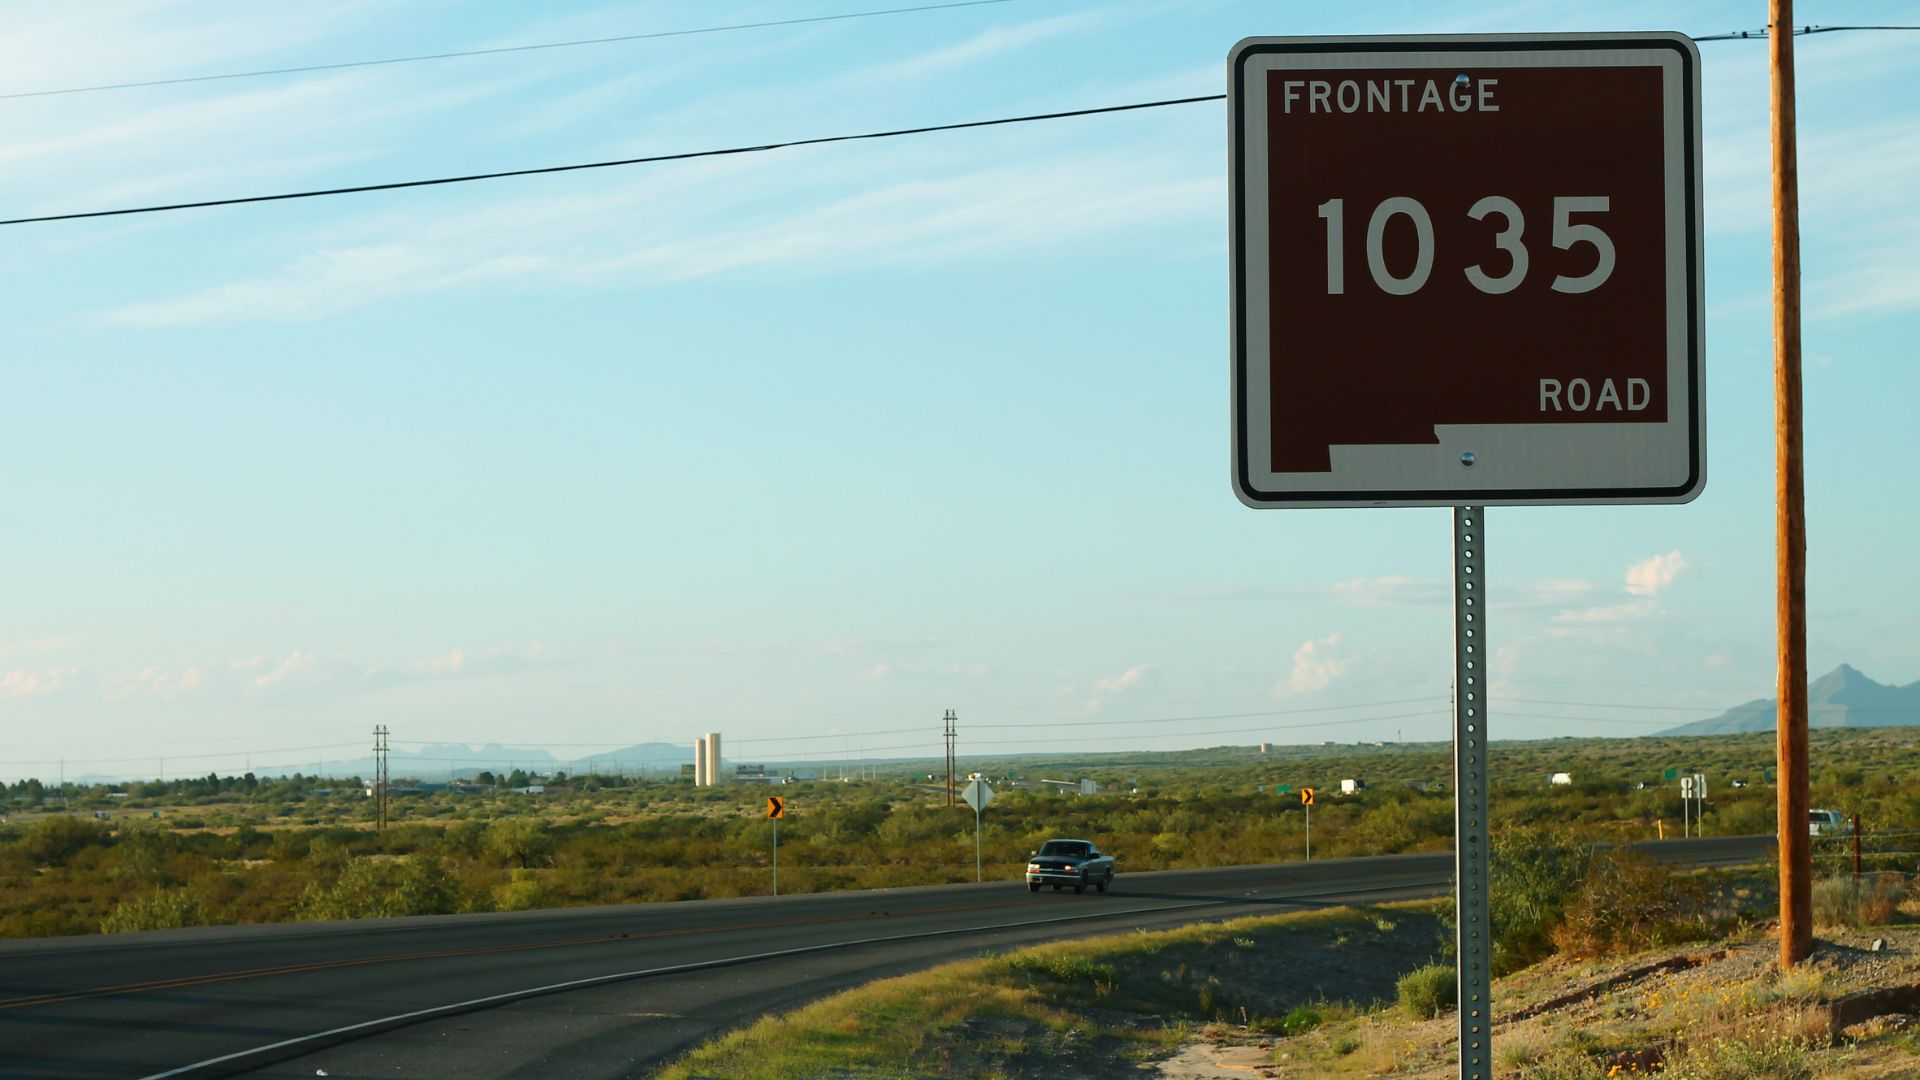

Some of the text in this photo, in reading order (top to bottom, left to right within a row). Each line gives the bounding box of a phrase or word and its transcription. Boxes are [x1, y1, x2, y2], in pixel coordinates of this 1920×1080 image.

[1283, 79, 1500, 112] FRONTAGE
[1317, 195, 1616, 295] 1035
[1540, 378, 1651, 412] ROAD
